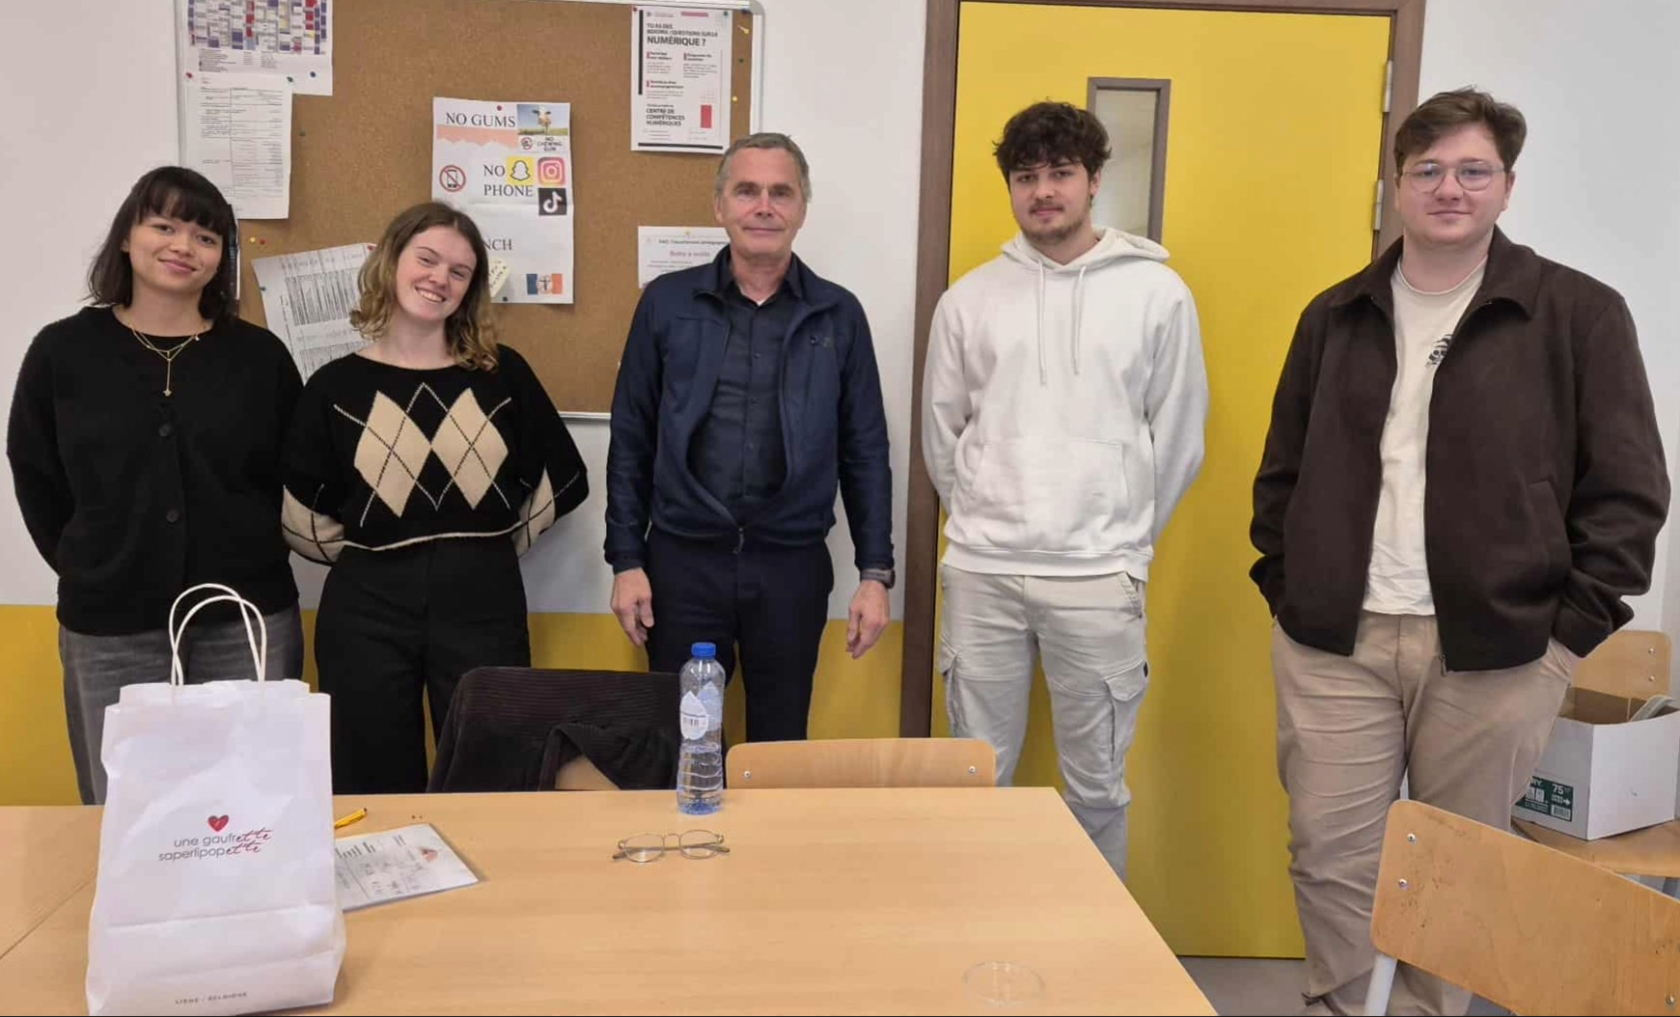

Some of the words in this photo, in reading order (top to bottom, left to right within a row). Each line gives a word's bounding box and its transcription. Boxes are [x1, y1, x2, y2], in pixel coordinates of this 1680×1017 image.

[647, 36, 700, 46] NUMÉRIQUE
[702, 38, 706, 46] ?
[446, 112, 467, 125] NO
[471, 114, 516, 127] GUMS
[483, 164, 505, 177] NO
[484, 184, 534, 197] PHONE
[483, 238, 513, 251] NCH
[1552, 784, 1564, 794] 75
[173, 836, 199, 848] une
[202, 827, 274, 847] gaufrette
[158, 839, 263, 862] saperlipopette
